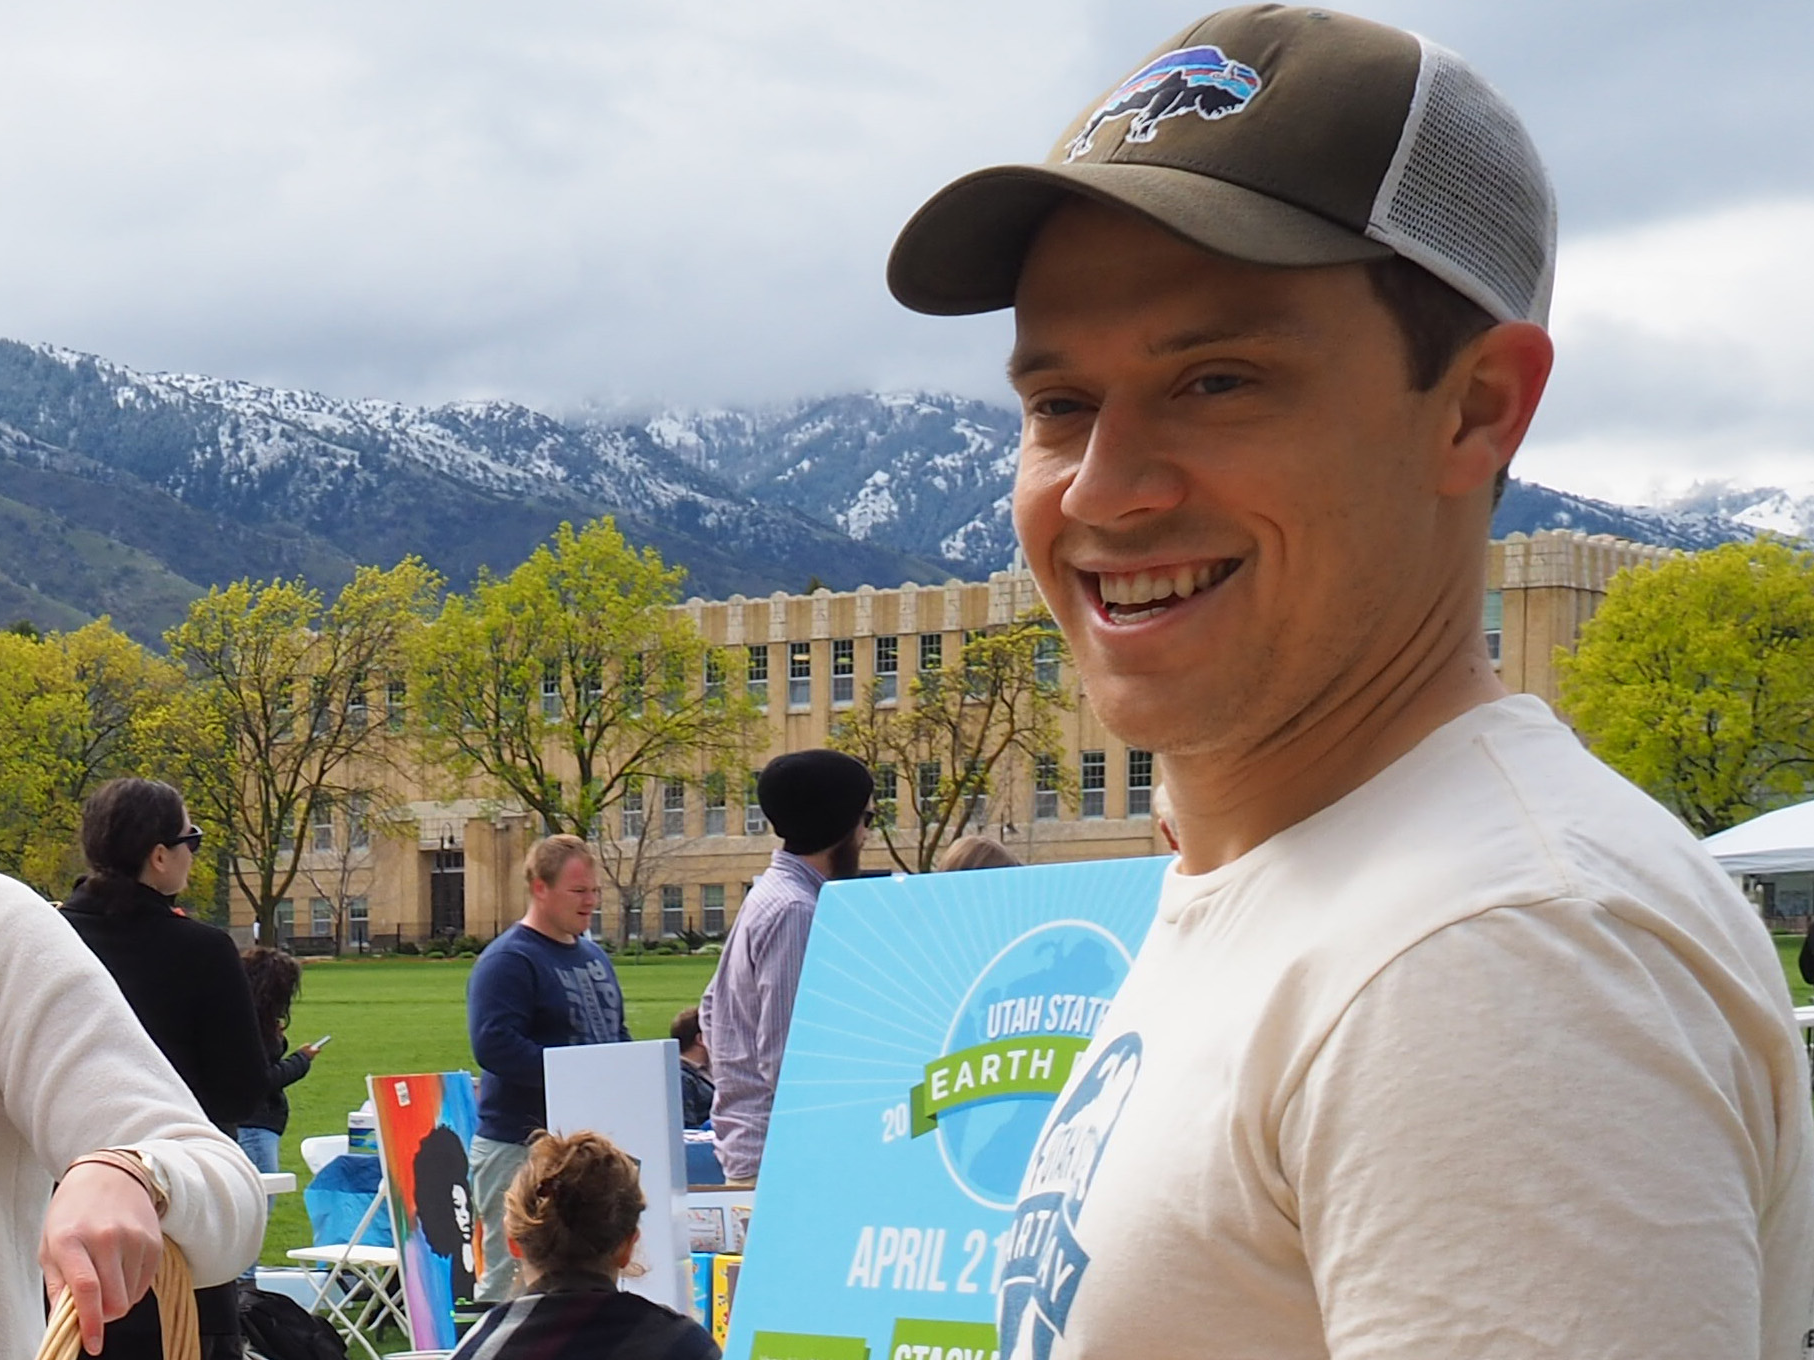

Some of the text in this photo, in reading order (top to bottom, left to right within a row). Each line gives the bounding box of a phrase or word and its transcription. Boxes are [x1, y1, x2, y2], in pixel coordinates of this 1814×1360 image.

[987, 996, 1044, 1039] UTAH
[931, 1049, 1055, 1100] EARTH
[847, 1227, 946, 1293] APRIL
